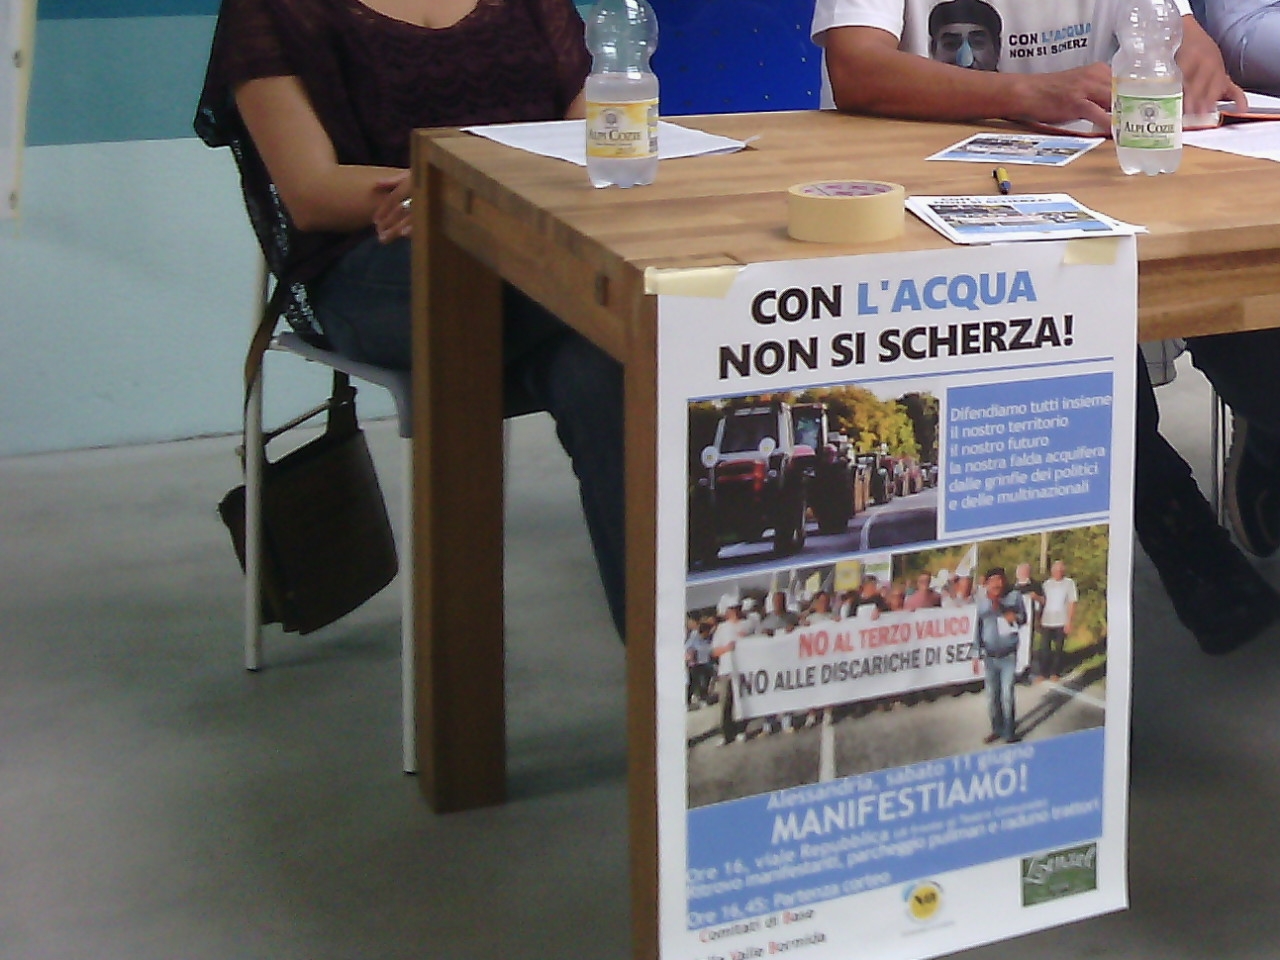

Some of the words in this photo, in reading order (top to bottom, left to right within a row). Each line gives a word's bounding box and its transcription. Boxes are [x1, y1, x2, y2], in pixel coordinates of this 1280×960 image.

[1009, 33, 1038, 46] CON
[1010, 48, 1034, 58] NON
[1037, 46, 1047, 56] SI
[751, 284, 842, 325] CON
[857, 270, 1037, 315] L'ACQUA
[719, 337, 818, 380] NON
[830, 332, 865, 368] SI
[878, 315, 1074, 363] SCHERZA!
[951, 404, 1026, 421] Difendiamo
[1031, 398, 1058, 413] tutti
[1063, 395, 1112, 409] insieme
[962, 423, 1005, 438] nostro
[1008, 415, 1069, 433] territorio
[962, 440, 1004, 455] nostro
[1008, 435, 1049, 450] futuro
[799, 630, 829, 659] NO
[833, 631, 853, 653] AL
[859, 622, 911, 649] TERZO
[915, 615, 970, 640] VALICO
[739, 669, 769, 698] NO
[773, 665, 816, 691] ALLE
[820, 648, 920, 684] DISCARICHE
[925, 646, 940, 666] DI
[771, 763, 1028, 845] MANIFESTIAMO!
